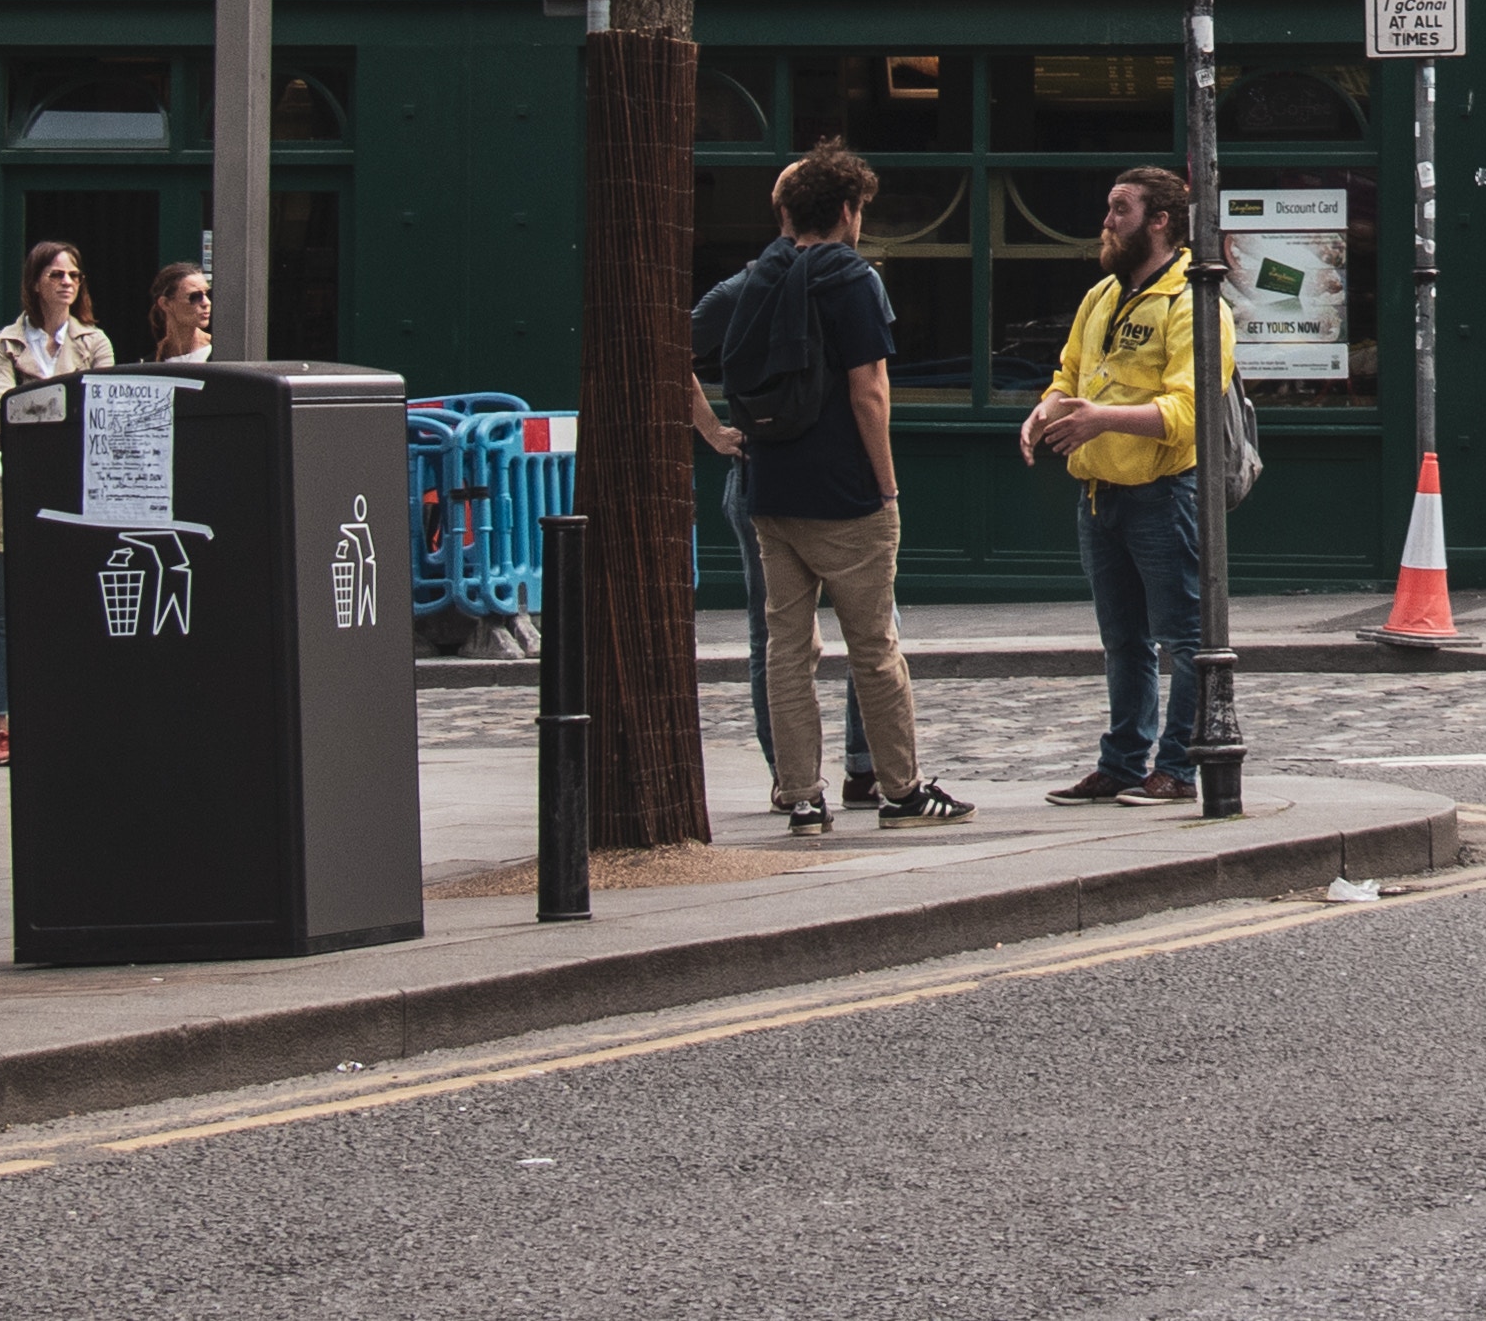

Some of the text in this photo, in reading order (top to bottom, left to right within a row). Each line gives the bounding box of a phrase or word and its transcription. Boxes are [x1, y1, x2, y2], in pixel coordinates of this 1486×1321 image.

[1388, 14, 1443, 29] AT ALL
[1391, 32, 1440, 47] TIMES
[1275, 201, 1339, 215] Discount Card
[1247, 321, 1321, 335] GET YOURS NOW
